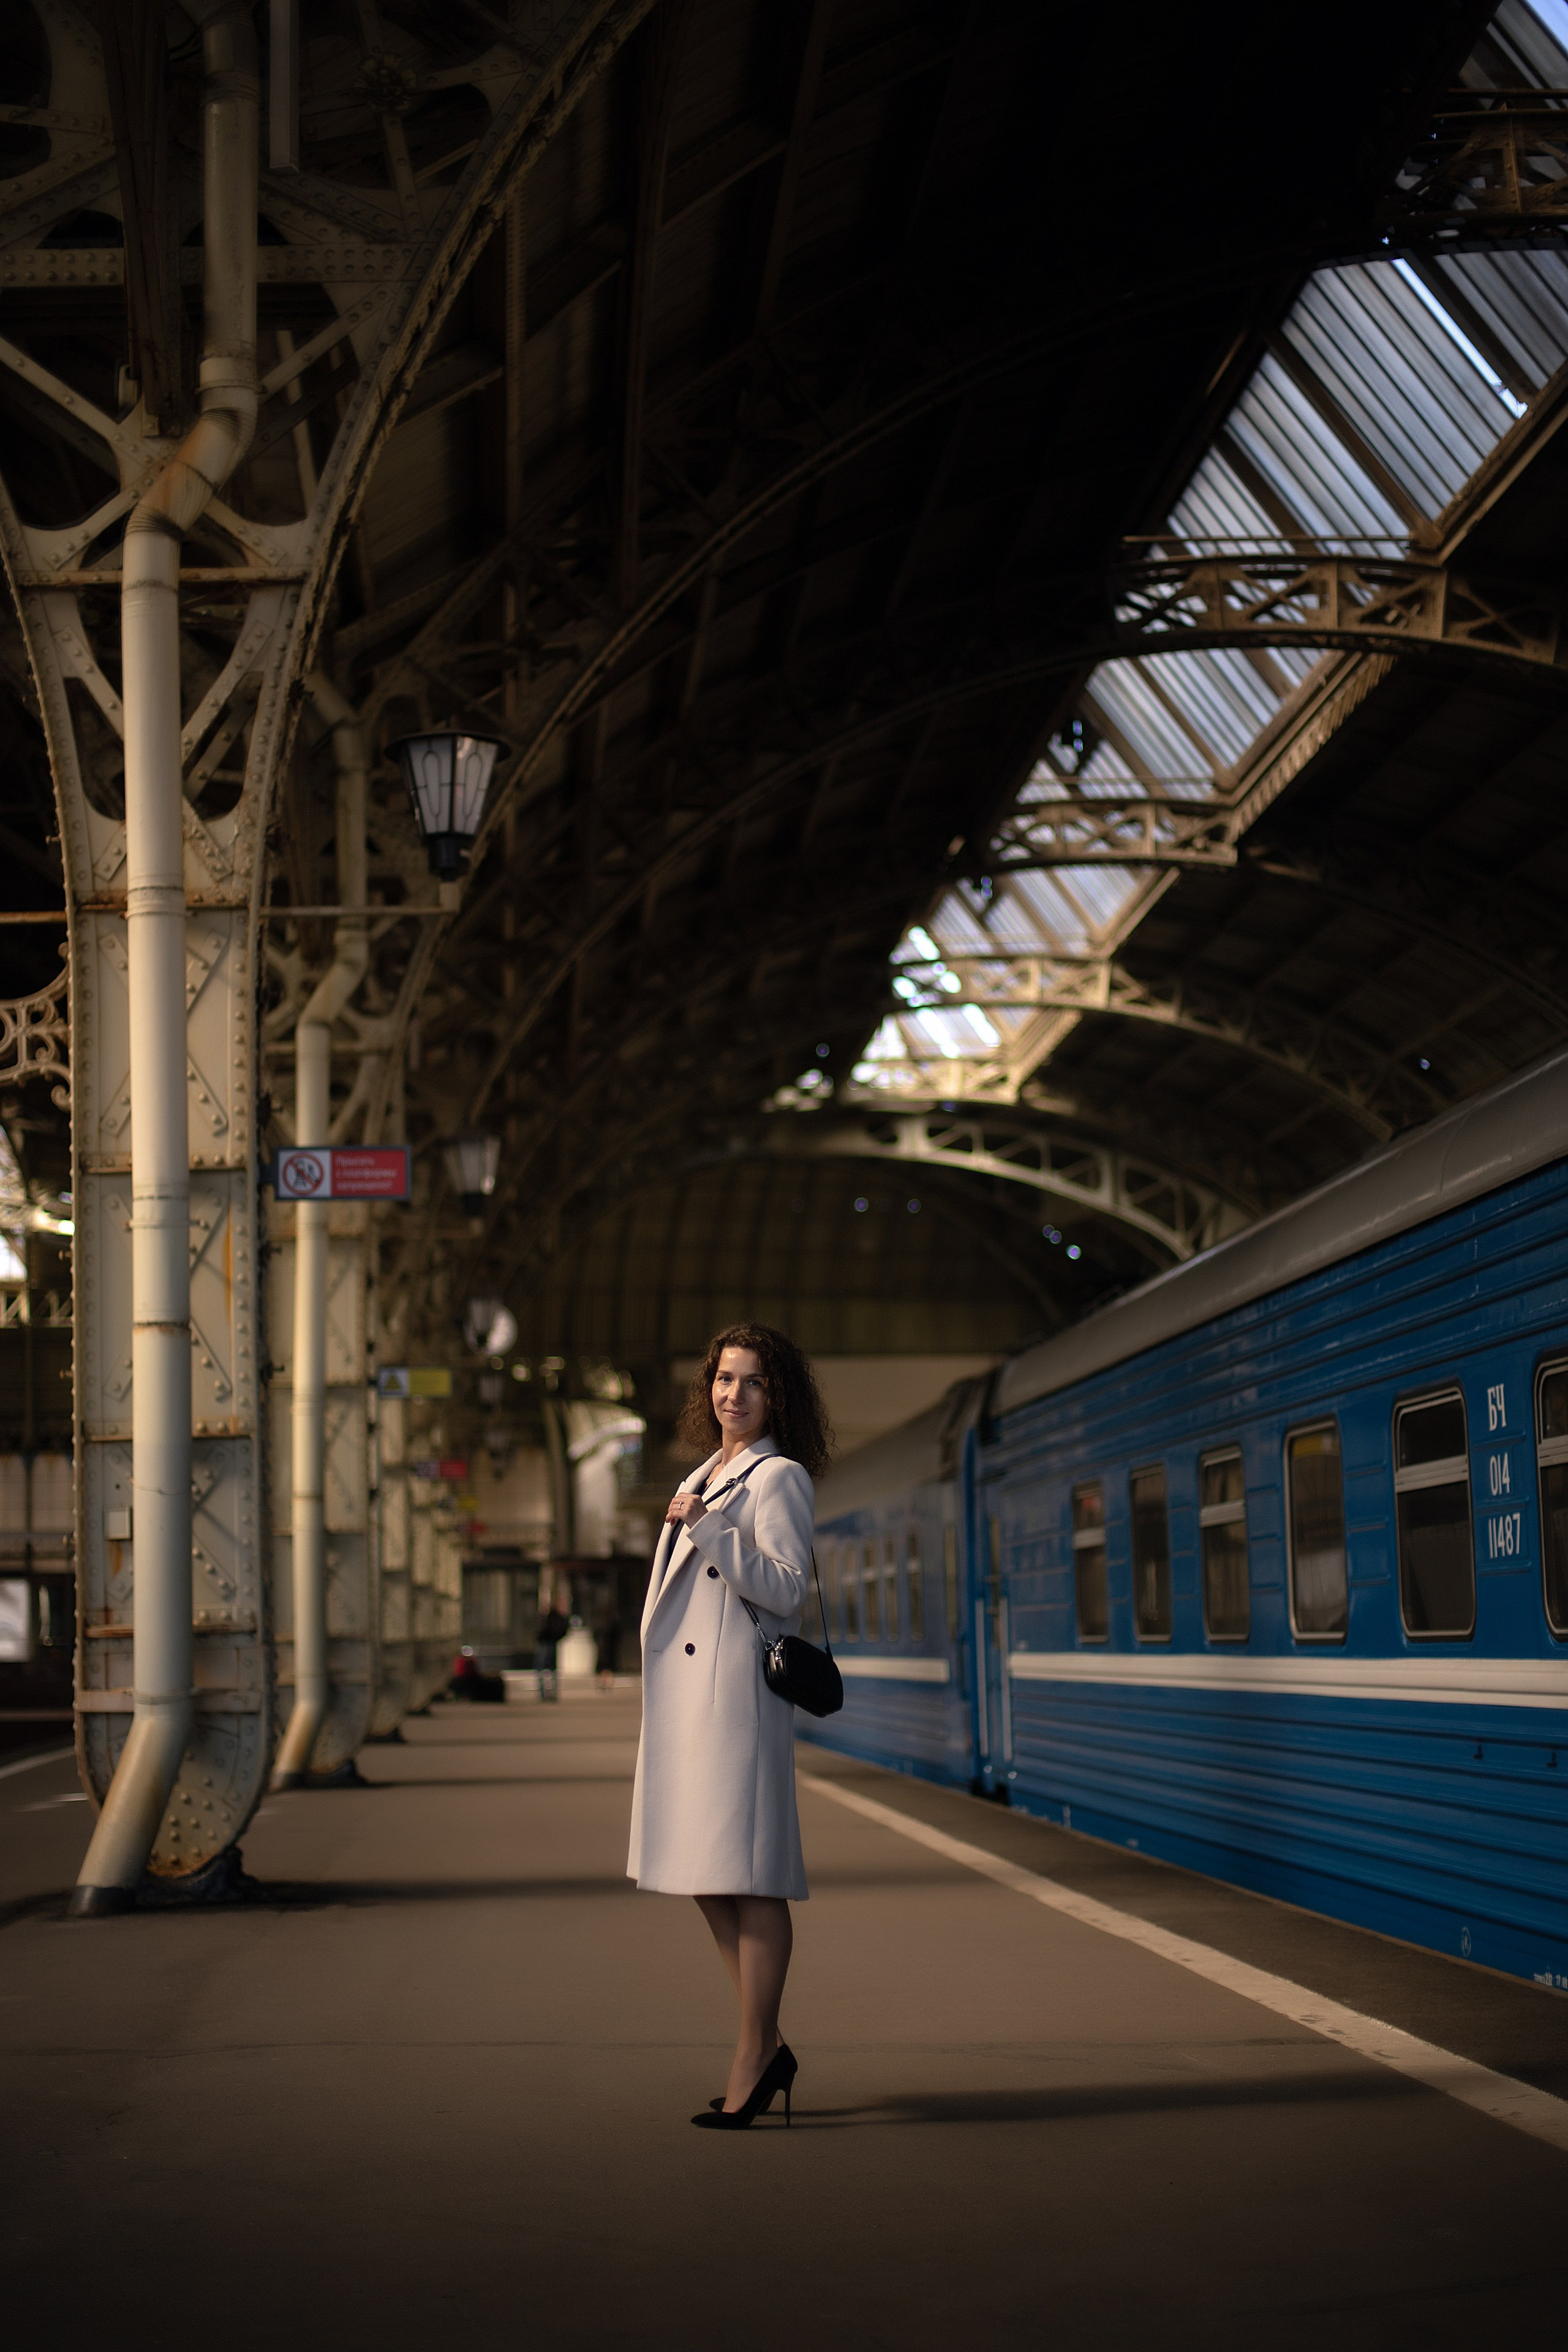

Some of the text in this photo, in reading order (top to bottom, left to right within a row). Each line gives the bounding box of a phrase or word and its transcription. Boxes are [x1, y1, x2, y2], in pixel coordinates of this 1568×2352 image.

[1487, 1383, 1507, 1431] БЧ
[1490, 1452, 1510, 1496] 014
[1488, 1512, 1520, 1559] 11487
